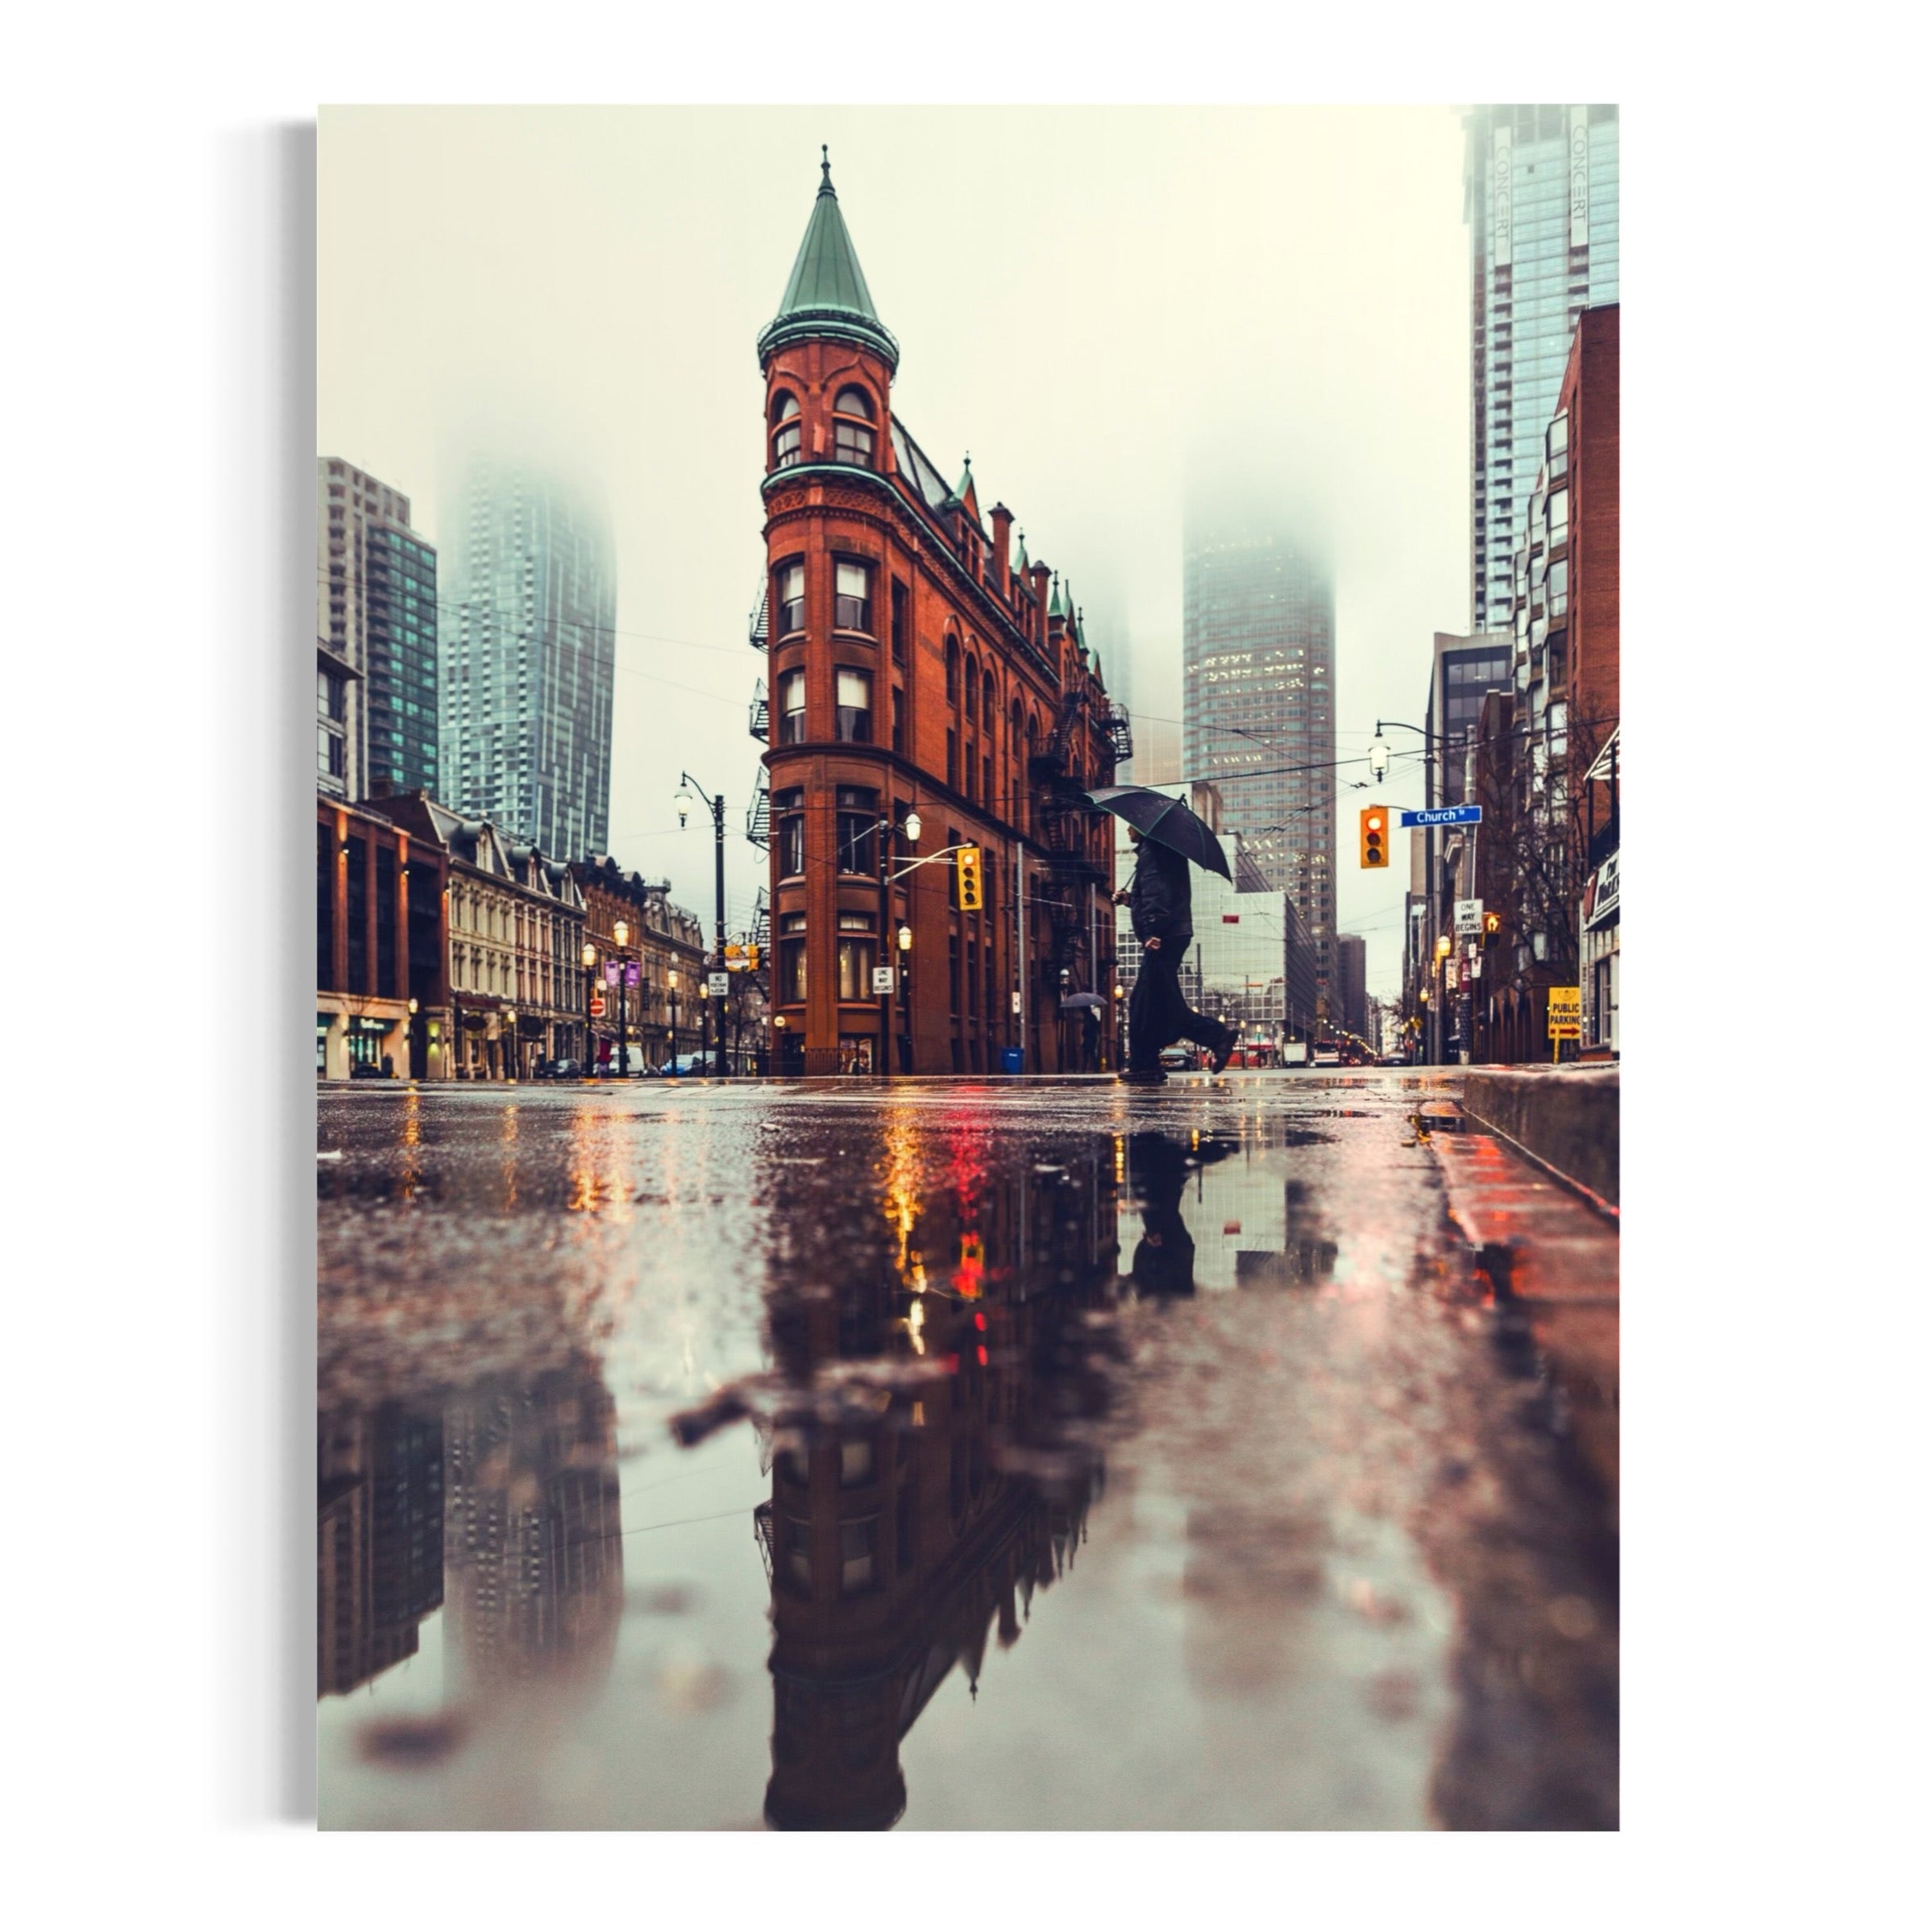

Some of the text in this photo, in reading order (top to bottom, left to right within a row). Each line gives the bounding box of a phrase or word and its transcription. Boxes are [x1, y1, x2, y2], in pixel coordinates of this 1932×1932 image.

[1573, 124, 1587, 222] CONCERT
[1497, 146, 1510, 240] CONCERT
[1416, 810, 1456, 823] Church
[1460, 903, 1476, 911] ONE
[1461, 912, 1476, 921] WAY
[1456, 923, 1481, 932] BEGINS
[1552, 1003, 1580, 1014] PUBLIC
